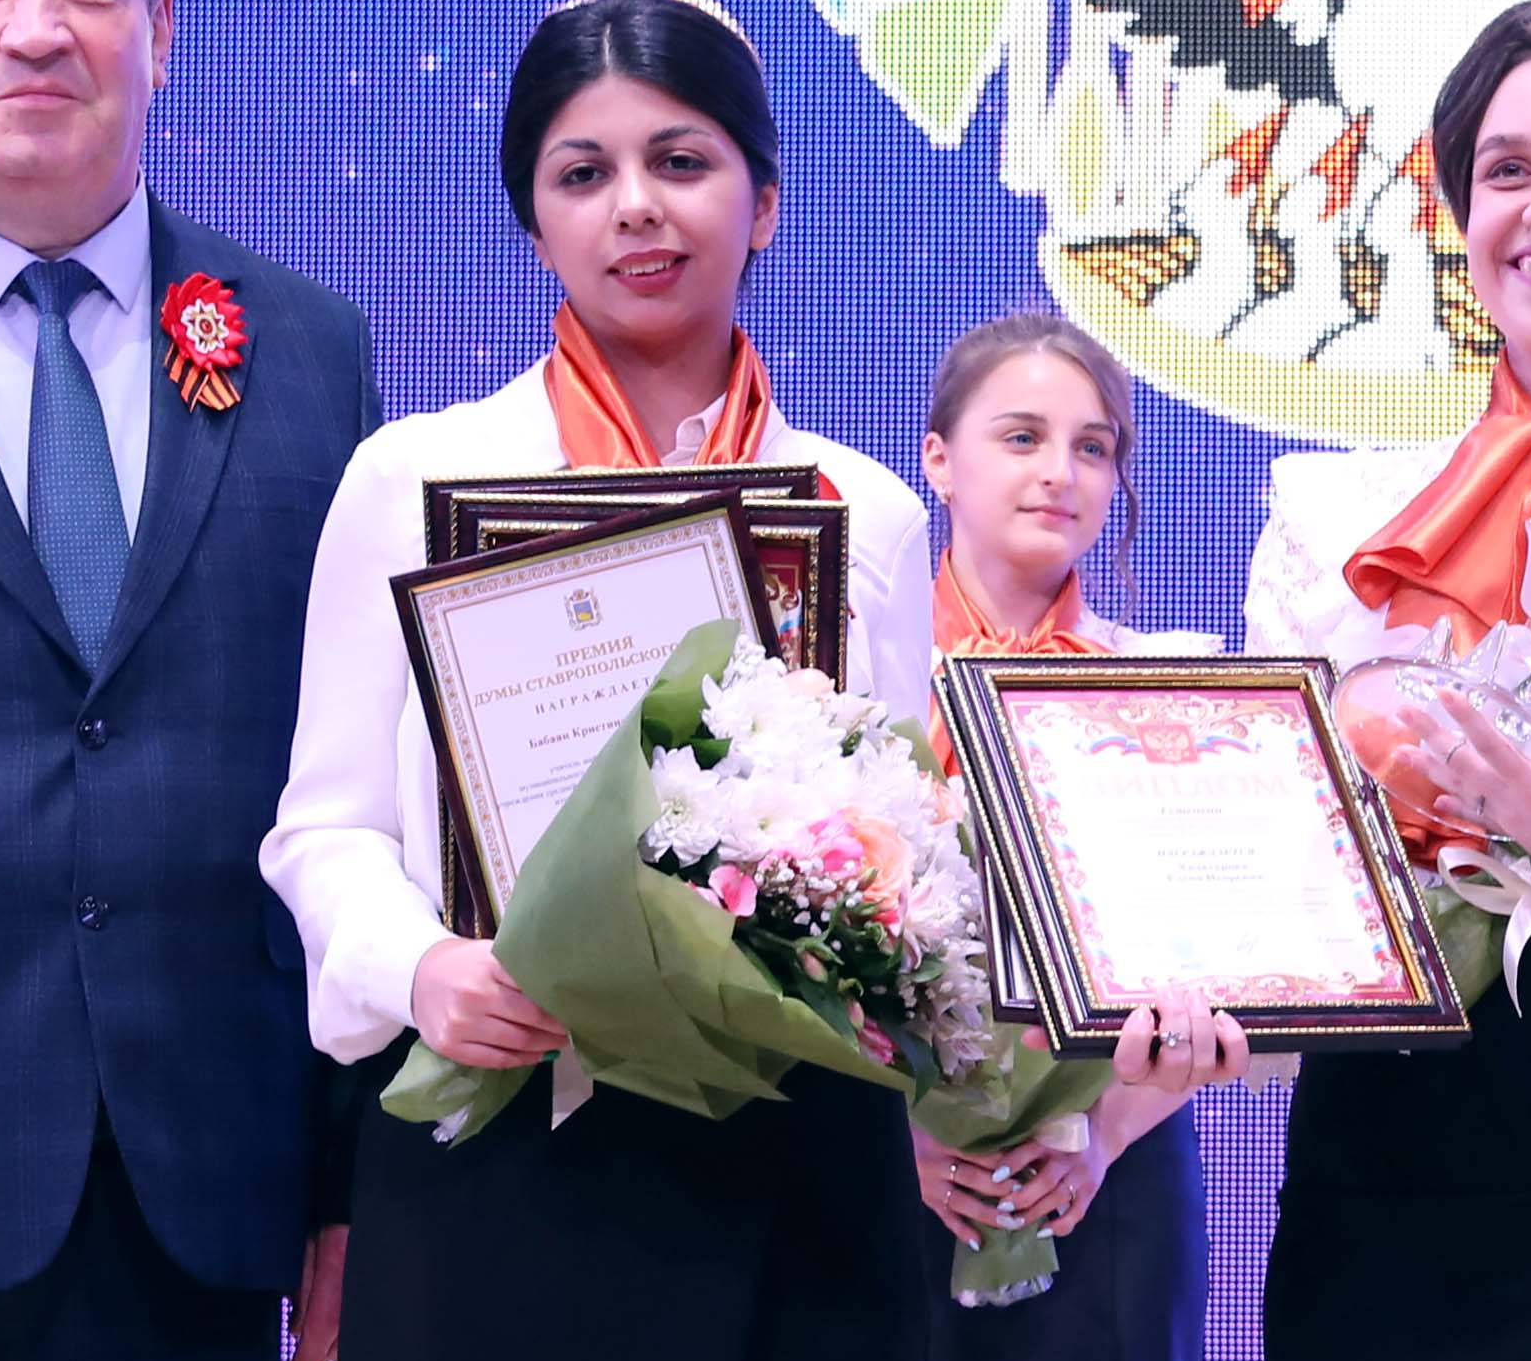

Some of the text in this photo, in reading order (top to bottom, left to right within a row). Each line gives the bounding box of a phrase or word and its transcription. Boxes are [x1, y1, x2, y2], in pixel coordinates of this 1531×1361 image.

[555, 635, 634, 668] ПРЕМИЯ
[473, 682, 524, 708] ДУМЫ
[534, 675, 651, 716] НАГРАЖДАЕТ
[571, 718, 621, 738] Кристин
